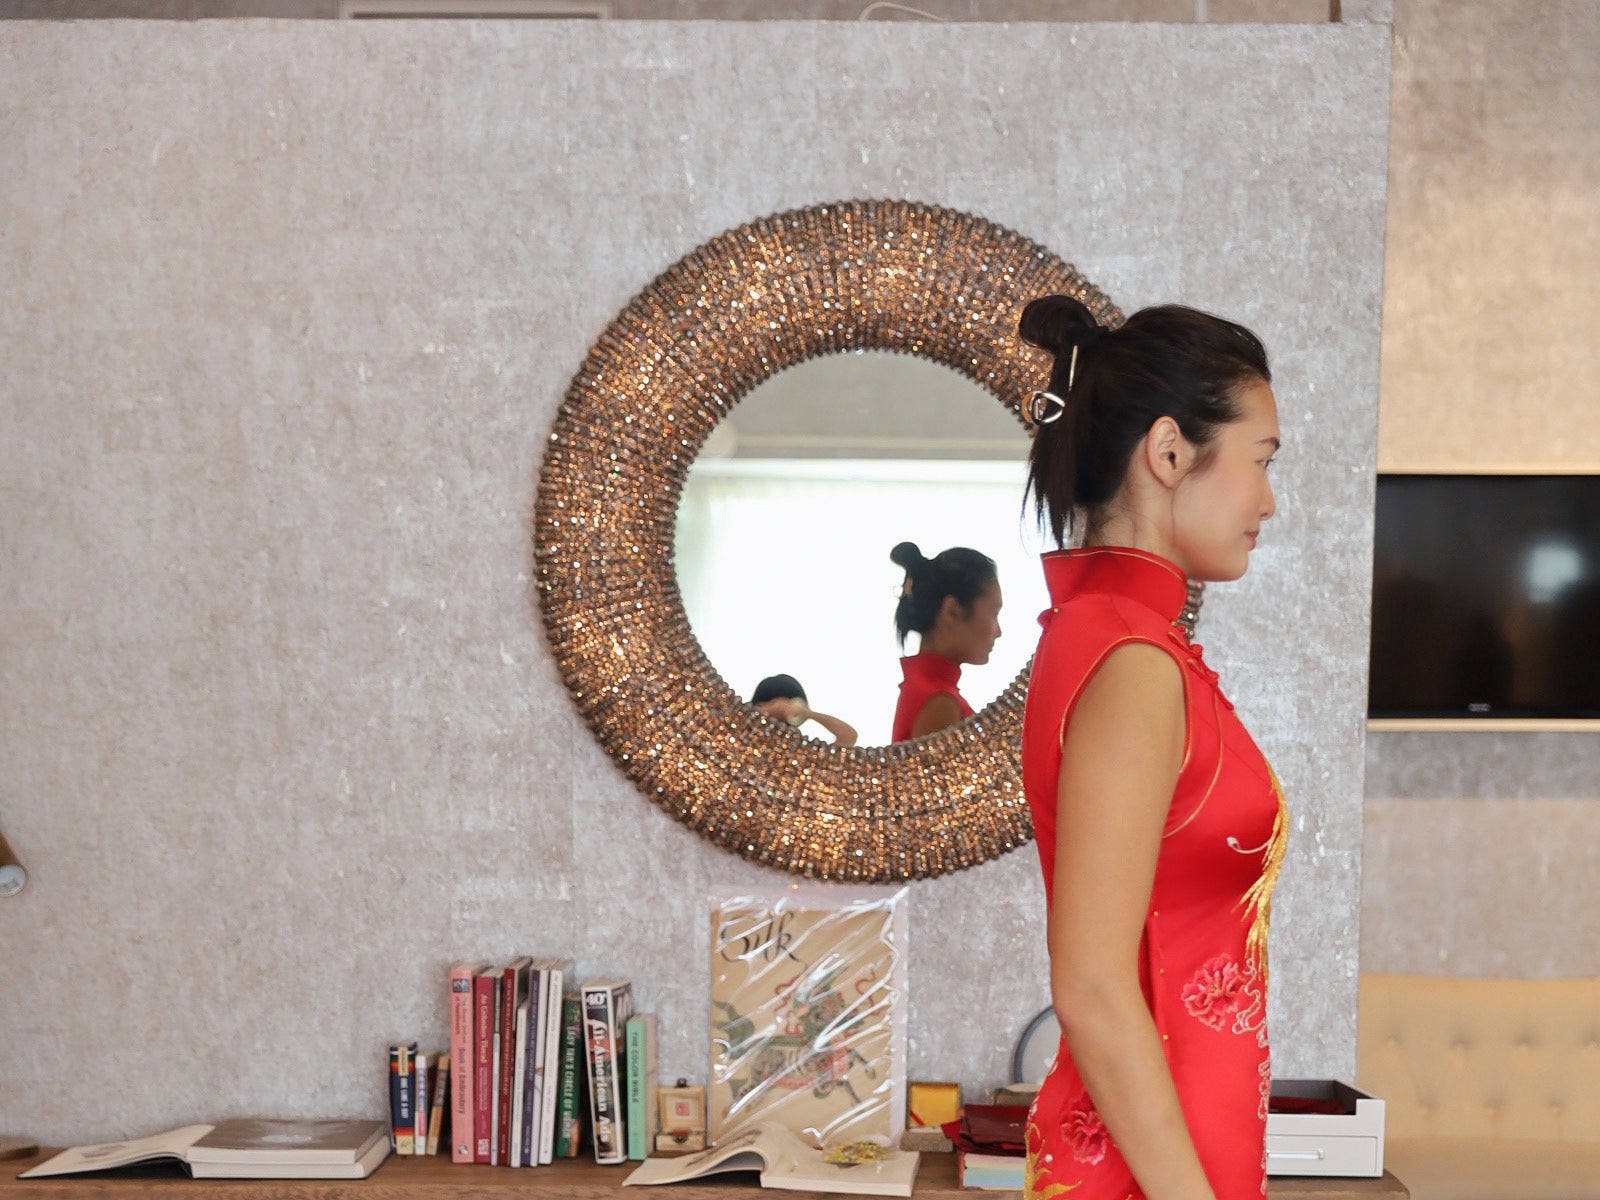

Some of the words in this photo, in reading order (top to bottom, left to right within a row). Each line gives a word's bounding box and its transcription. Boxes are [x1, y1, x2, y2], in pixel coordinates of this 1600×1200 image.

[720, 910, 801, 963] Silk
[586, 1019, 610, 1112] All-American
[598, 1115, 612, 1142] Ads
